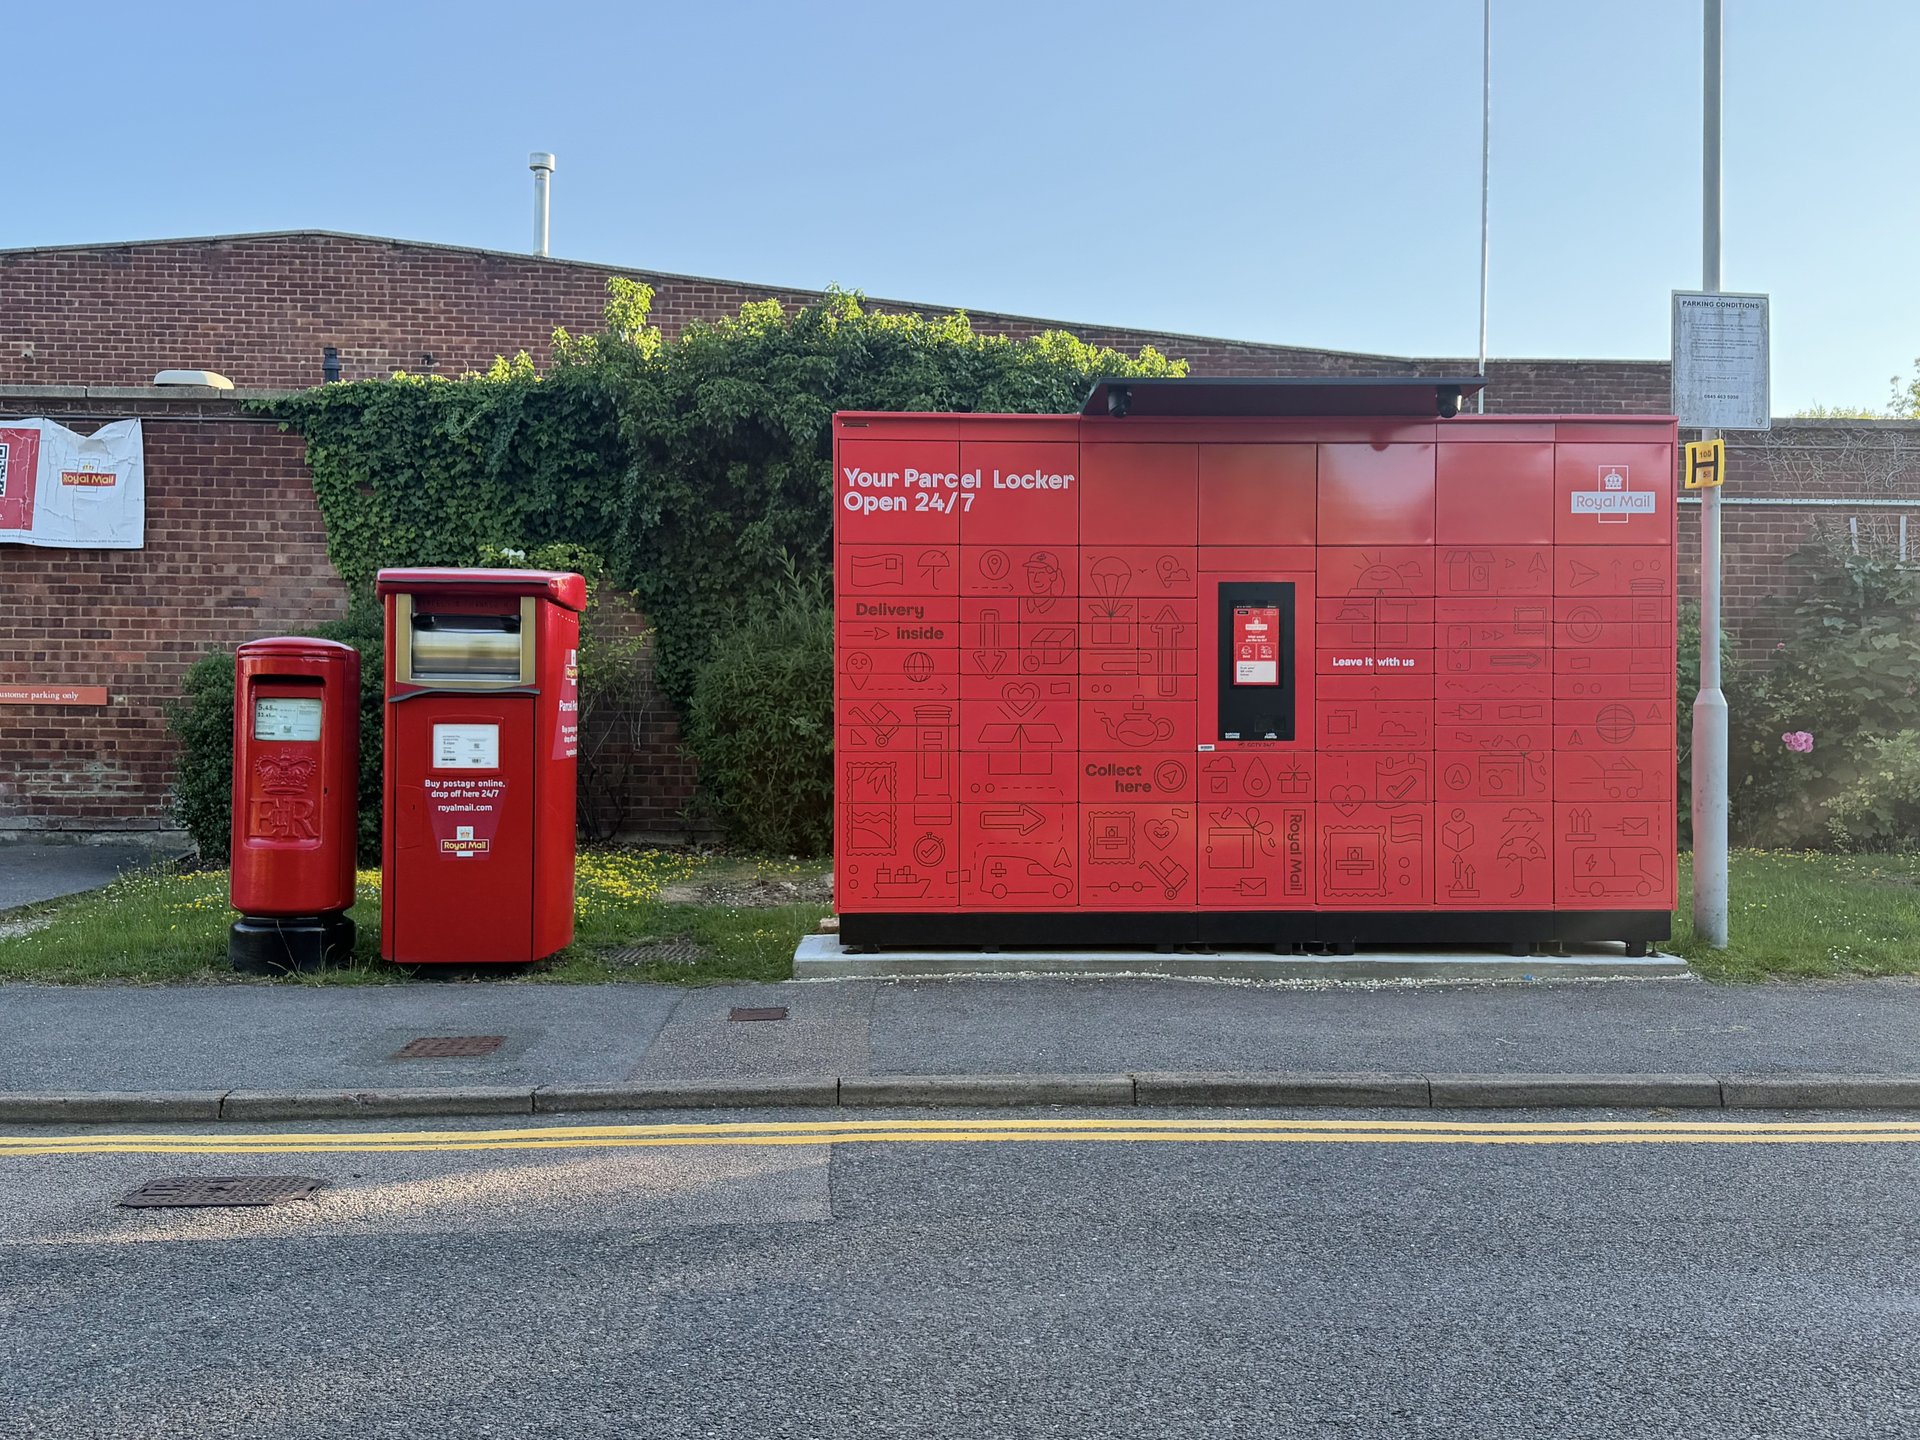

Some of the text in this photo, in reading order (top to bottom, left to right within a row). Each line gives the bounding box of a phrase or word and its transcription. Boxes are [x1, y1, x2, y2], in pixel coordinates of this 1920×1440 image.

[1682, 300, 1760, 309] PARKING CONDITIONS
[1691, 444, 1719, 484] H
[62, 473, 114, 485] Royal Mail
[843, 467, 1075, 490] Your Parcel Locker
[843, 491, 976, 516] Open 24/7
[1576, 495, 1650, 511] Royal Mail
[856, 602, 925, 619] Delivery
[896, 626, 945, 641] inside
[1332, 656, 1415, 667] Leave it with us
[31, 691, 60, 701] parking
[62, 691, 79, 701] only
[1085, 763, 1142, 777] Collect
[424, 779, 441, 789] Buy
[443, 780, 476, 789] postage
[1114, 780, 1152, 793] here
[431, 789, 499, 799] drop off here 24/7
[437, 803, 493, 813] royalmail.com
[443, 841, 487, 851] Royal Mail
[1286, 814, 1303, 891] Royal Mail
